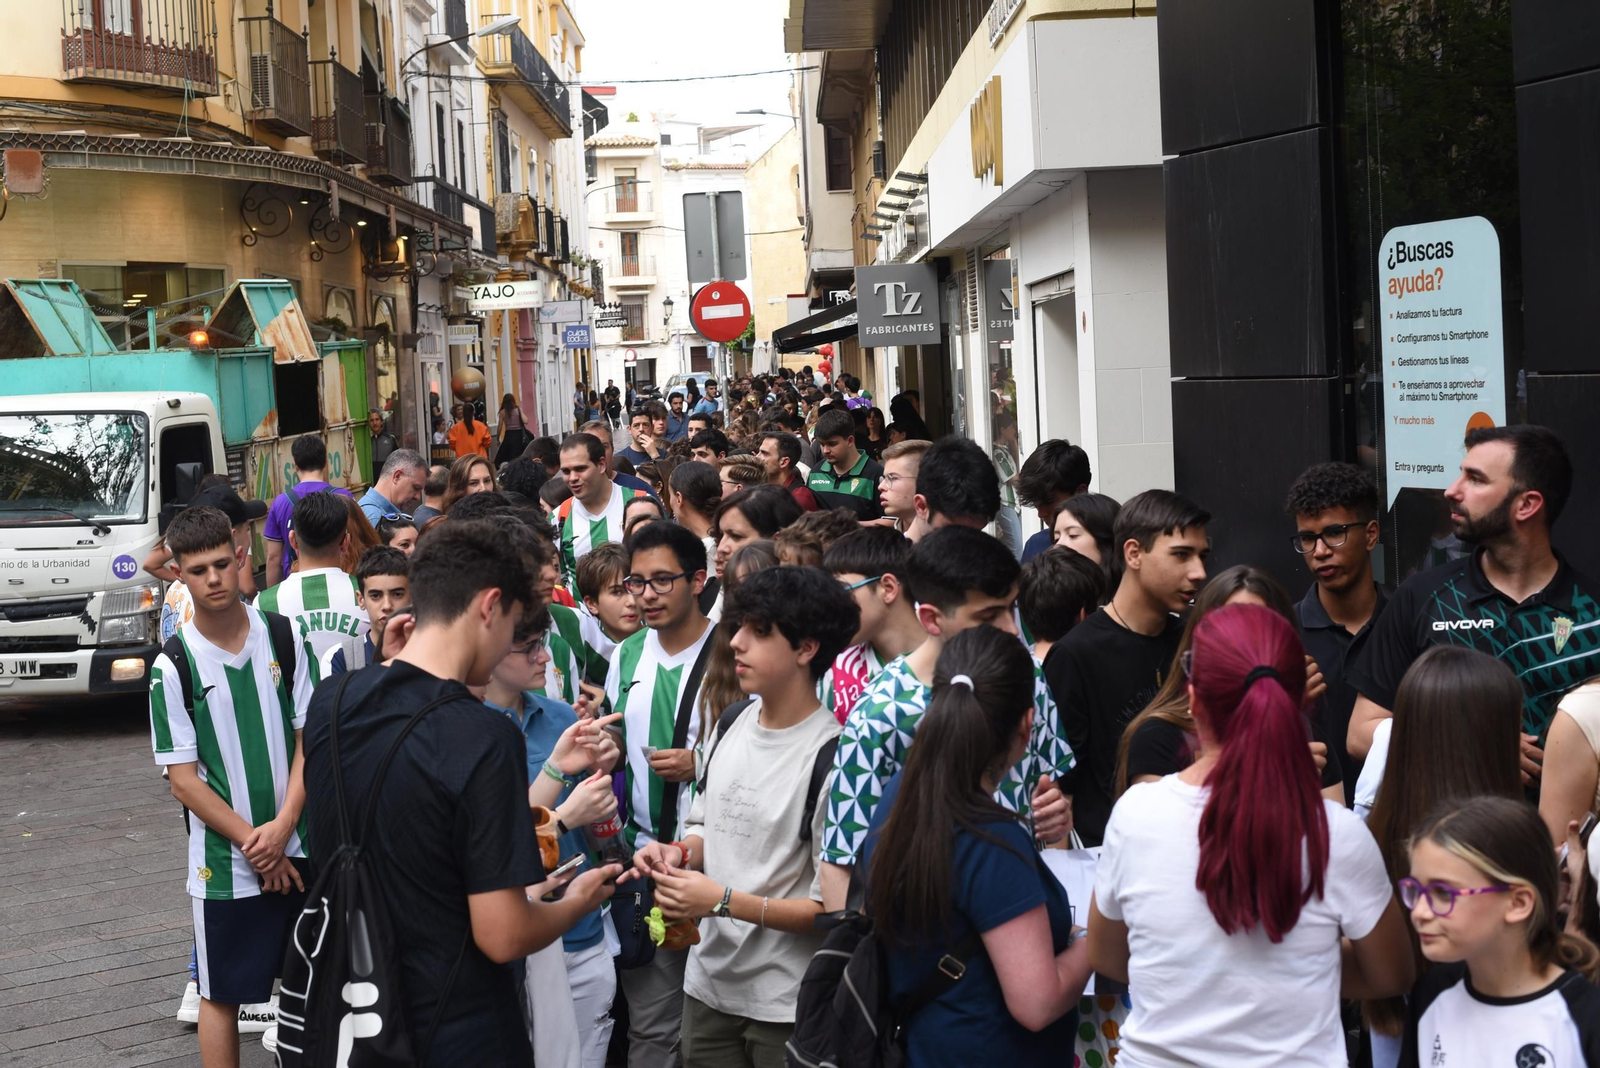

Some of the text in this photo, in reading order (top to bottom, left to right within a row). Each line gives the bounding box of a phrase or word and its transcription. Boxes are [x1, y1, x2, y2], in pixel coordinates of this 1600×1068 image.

[1387, 240, 1454, 270] ¿Buscas
[1388, 267, 1444, 299] ayuda?
[470, 284, 515, 299] YAJO
[1396, 307, 1462, 320] Analizamos tu factura
[865, 323, 935, 335] FABRICANTES
[1396, 330, 1489, 344] Configuramos tu Smartphone
[1398, 355, 1469, 367] Gestionamos tus líneas
[1398, 381, 1406, 390] Te
[1407, 380, 1442, 389] enseñamos
[1448, 379, 1485, 390] aprovechar
[1399, 391, 1478, 402] al máximo tu Smartphone
[1393, 415, 1435, 425] Y mucho más
[1395, 462, 1445, 474] Entra y pregunta
[17, 560, 28, 569] de
[32, 559, 39, 568] la
[42, 559, 90, 568] Urbanidad
[114, 562, 136, 572] 130
[295, 611, 360, 638] ANUEL
[1432, 618, 1494, 631] GIVOVA
[10, 660, 38, 675] JWW
